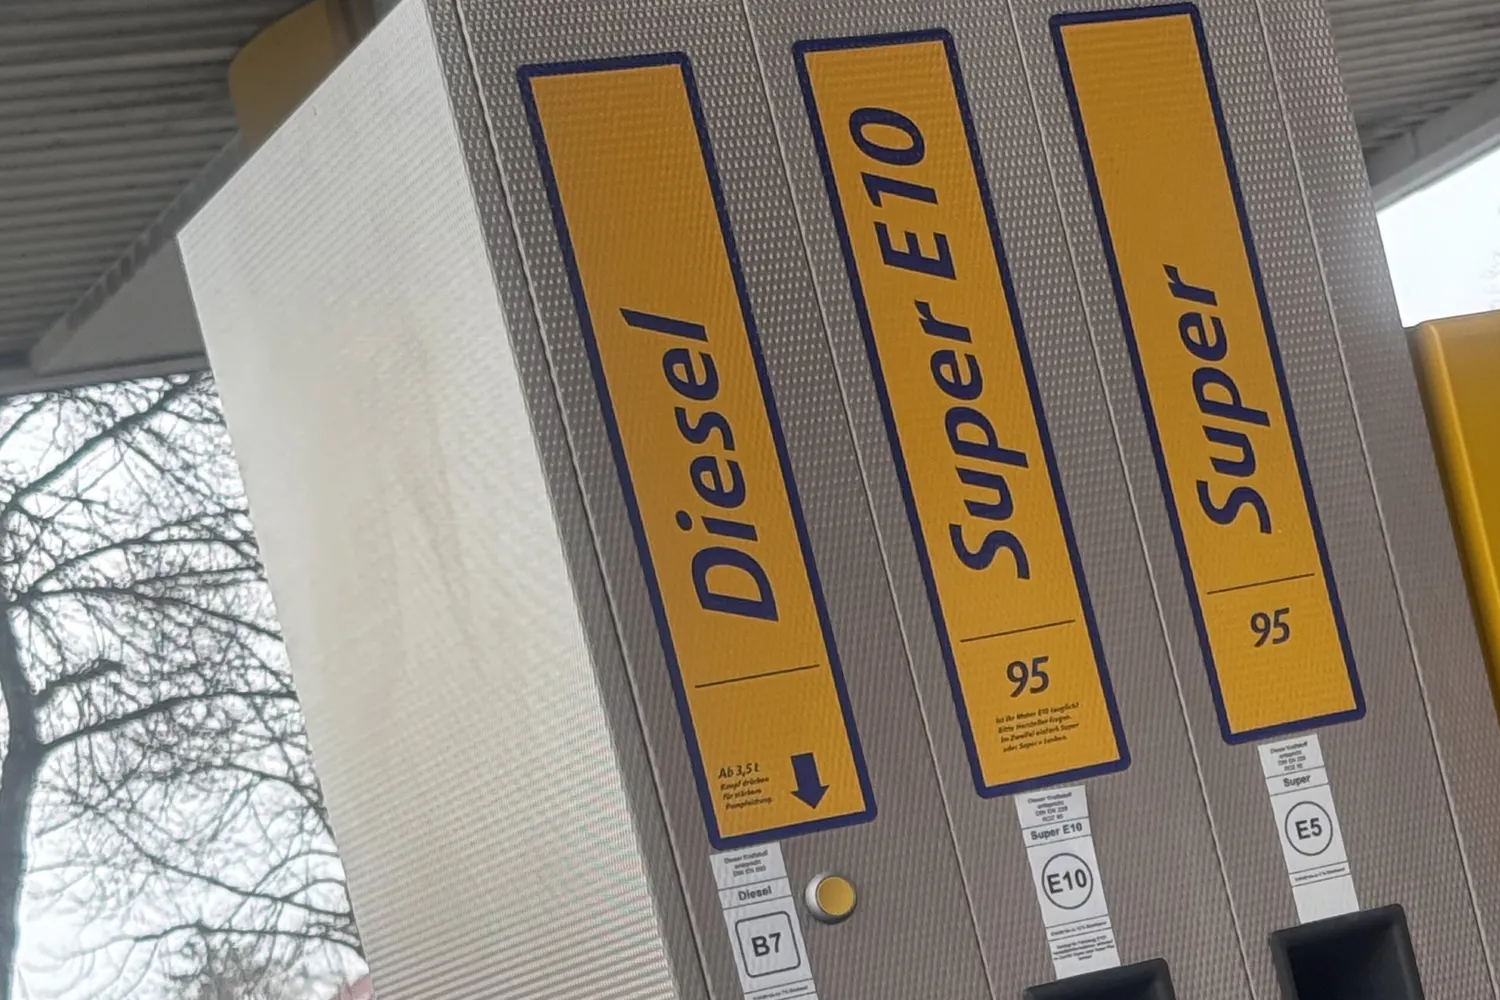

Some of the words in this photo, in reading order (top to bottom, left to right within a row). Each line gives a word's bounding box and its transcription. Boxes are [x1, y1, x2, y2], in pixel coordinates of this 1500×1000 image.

[848, 107, 956, 280] E10
[1162, 263, 1271, 535] Super
[913, 299, 1030, 580] Super
[619, 307, 779, 622] Diesel
[1250, 607, 1291, 648] 95
[1006, 655, 1050, 698] 95
[718, 766, 734, 779] Ab
[1283, 775, 1311, 787] Super
[1030, 828, 1060, 840] Super
[1062, 822, 1083, 835] E10
[1295, 817, 1323, 841] E5
[738, 885, 772, 901] Diesel
[1047, 868, 1087, 894] E10
[751, 932, 782, 957] B7
